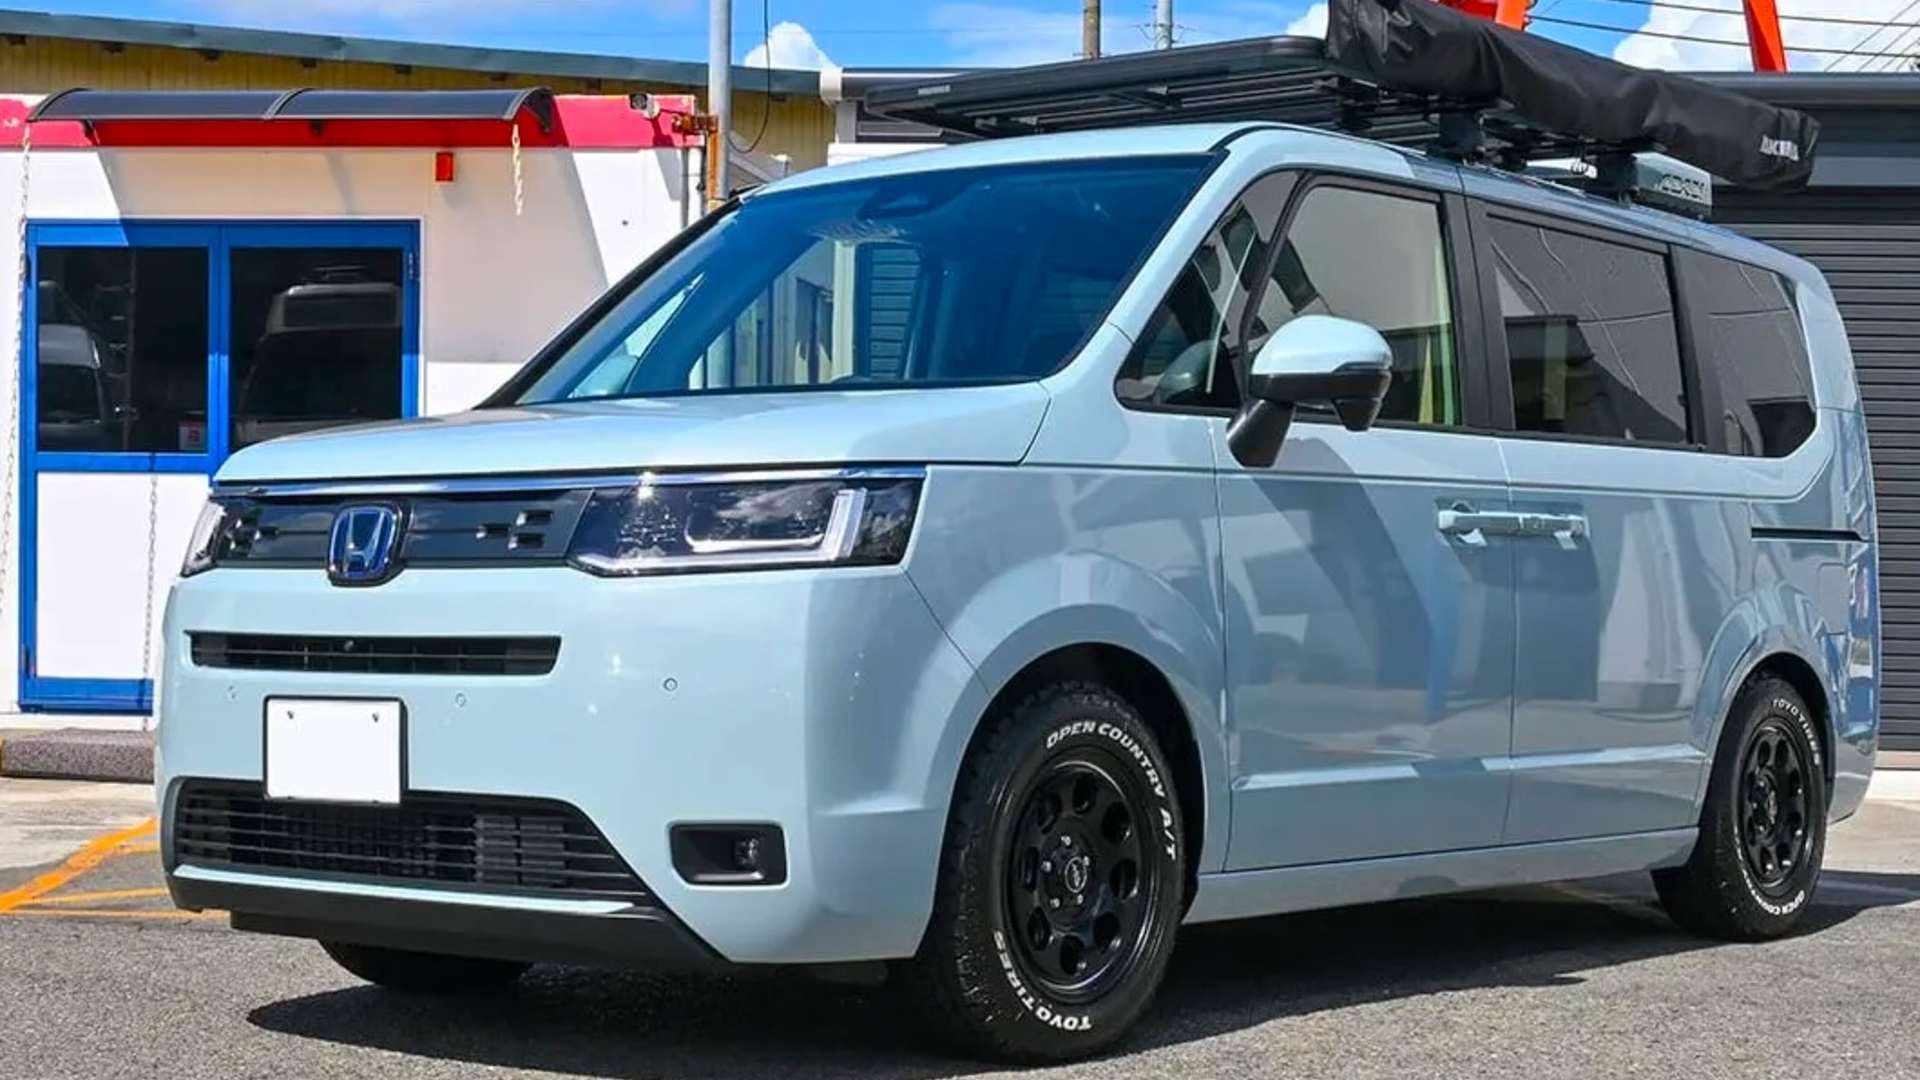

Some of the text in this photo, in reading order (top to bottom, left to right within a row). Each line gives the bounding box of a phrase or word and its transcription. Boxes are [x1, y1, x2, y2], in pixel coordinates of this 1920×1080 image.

[1046, 721, 1176, 861] OPEN COUNTRY A/T
[994, 931, 1092, 1031] TOYO TIRES
